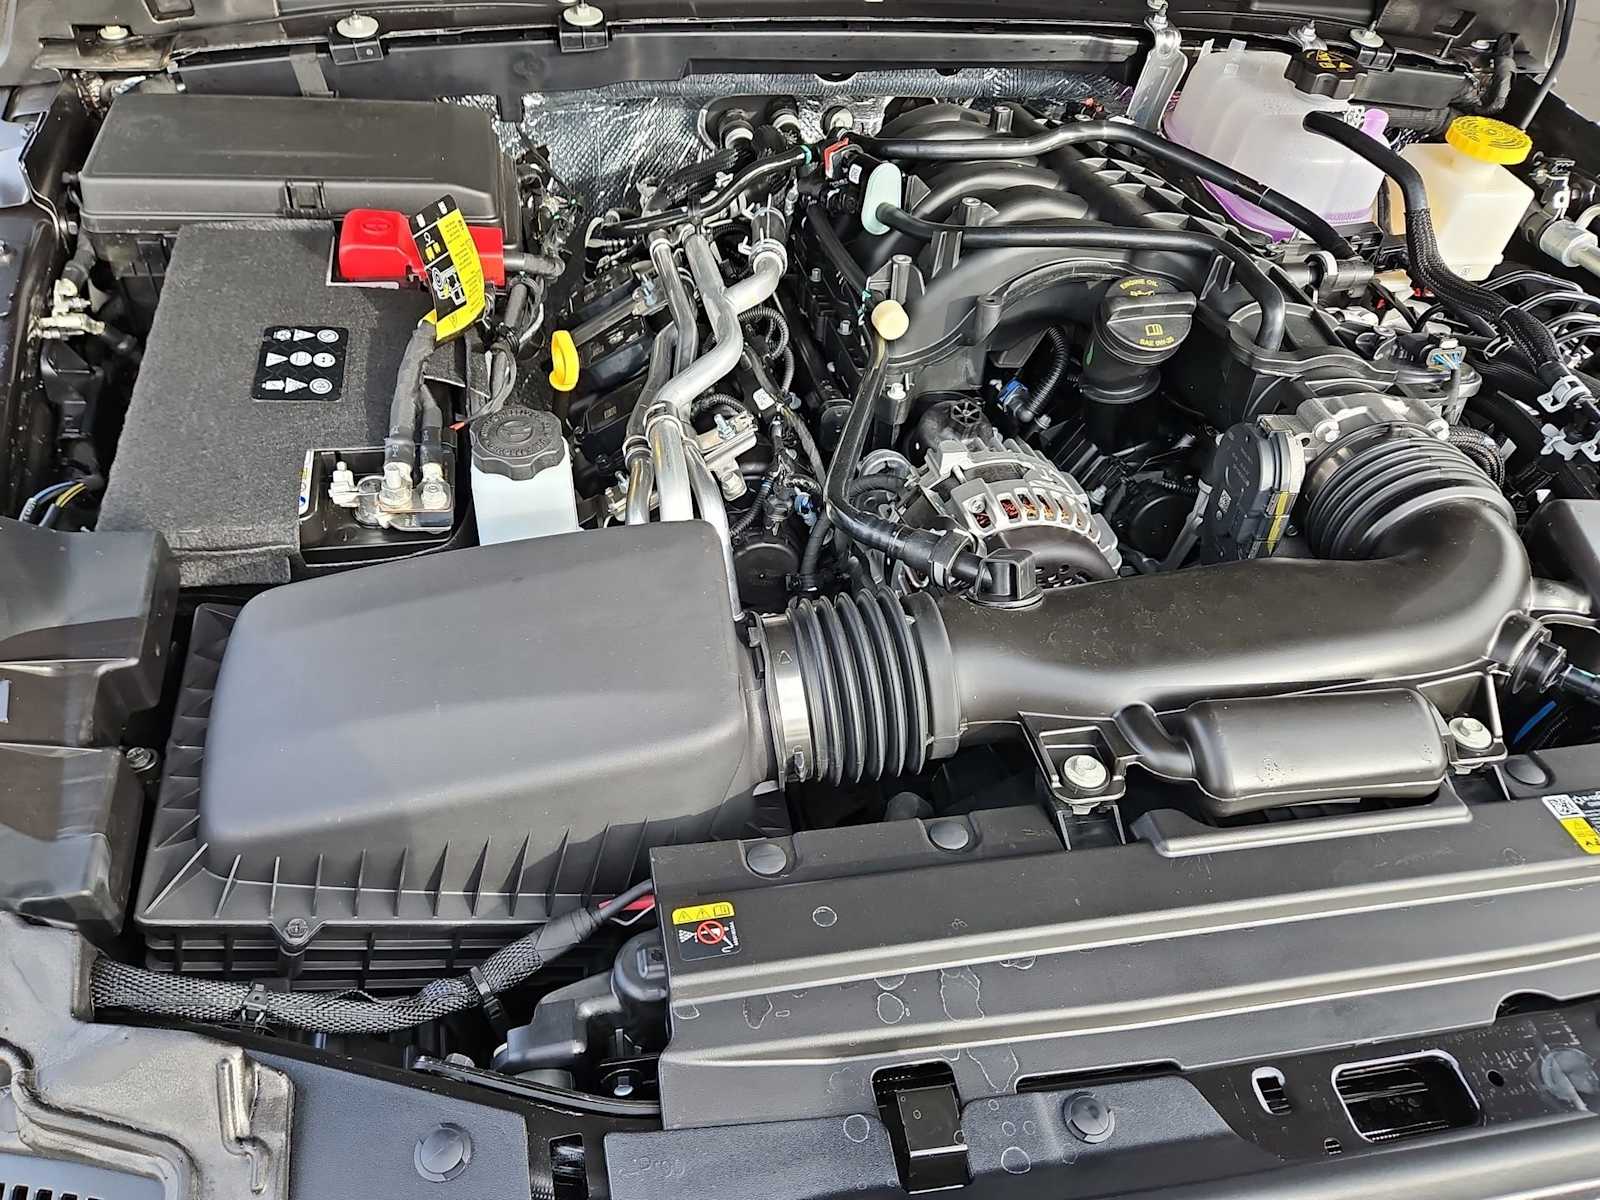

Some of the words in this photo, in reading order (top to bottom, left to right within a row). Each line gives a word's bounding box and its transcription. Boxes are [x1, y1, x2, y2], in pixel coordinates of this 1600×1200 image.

[1120, 279, 1145, 289] ENGINE
[1146, 279, 1158, 287] OIL
[1139, 338, 1154, 346] SAE
